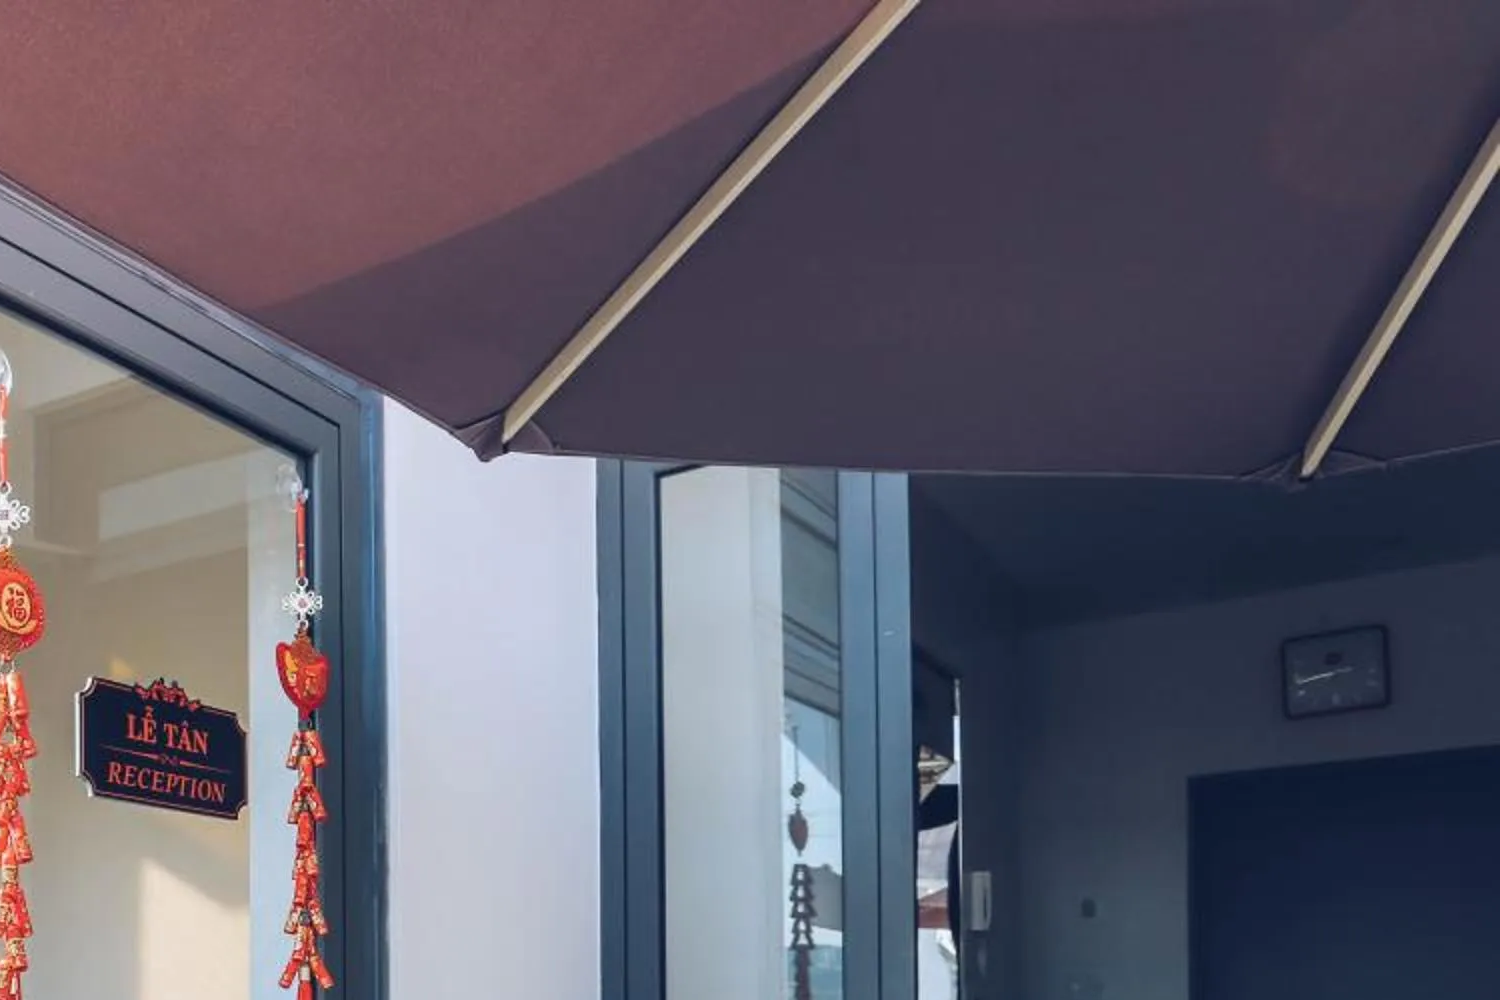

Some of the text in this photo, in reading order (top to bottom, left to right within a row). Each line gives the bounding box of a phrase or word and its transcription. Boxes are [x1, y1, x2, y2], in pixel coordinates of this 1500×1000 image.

[126, 704, 209, 755] LỄ TÂN
[107, 761, 227, 804] RECEPTION
